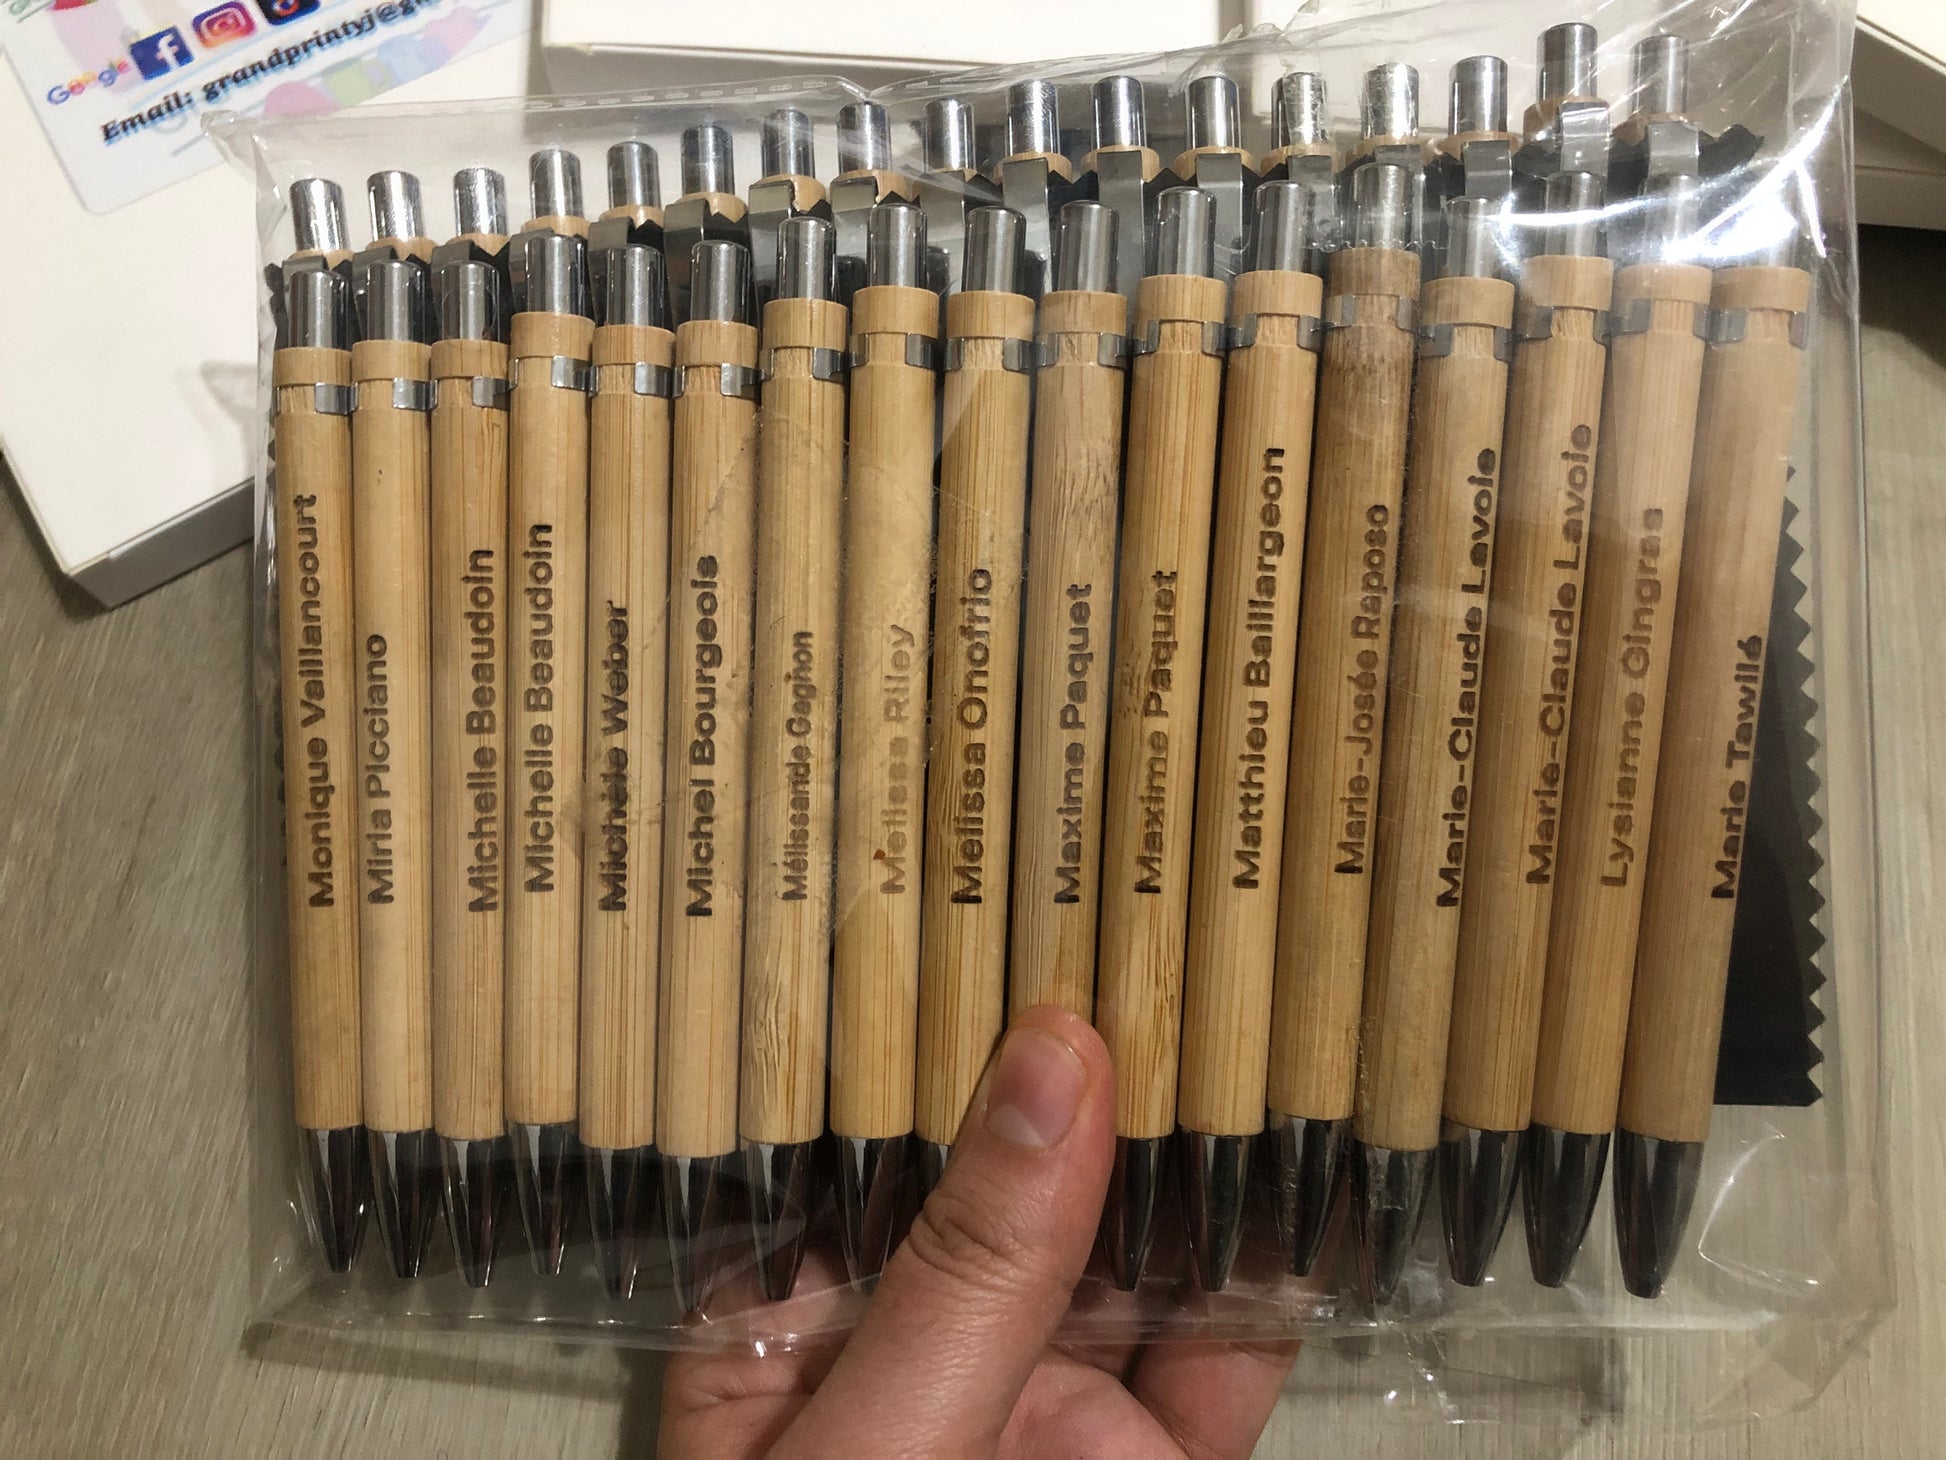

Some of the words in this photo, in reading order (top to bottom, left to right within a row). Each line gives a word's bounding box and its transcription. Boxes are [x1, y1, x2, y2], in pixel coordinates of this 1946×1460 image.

[101, 91, 193, 142] Email:
[203, 0, 436, 102] grandprintyj@g
[294, 494, 327, 728] Vaillancourt
[461, 549, 497, 735] Beaudoin
[524, 524, 554, 713] Beaudoin
[1143, 570, 1178, 718] Paquet
[1243, 447, 1285, 688] Baillargeon
[1351, 504, 1390, 640] Raposo
[1622, 507, 1663, 680] Gingras
[363, 634, 391, 797] Picciano
[602, 600, 629, 737] Weber
[689, 555, 723, 766] Bourgeois
[786, 631, 817, 737] Gagnon
[883, 624, 915, 723] Riley
[957, 568, 993, 731] Onofrio
[1060, 583, 1094, 730] Paquet
[1437, 605, 1483, 907] Marie-Claude
[1461, 448, 1496, 595] Lavoie
[1526, 582, 1577, 884] Marie-Claude
[1553, 424, 1592, 571] Lavoie
[307, 737, 335, 907] Monique
[466, 746, 499, 913] Michelle
[524, 724, 554, 893] Michelle
[880, 737, 910, 893] Melissa
[951, 742, 986, 904] Melissa
[1054, 742, 1085, 904] Maxime
[1134, 730, 1169, 894] Maxime
[1233, 701, 1268, 890] Matthieu
[1334, 648, 1379, 874] Marie-José
[1602, 692, 1646, 886] Lysianne
[1711, 779, 1746, 899] Marie
[366, 809, 394, 903] Miria
[685, 779, 715, 917] Michel
